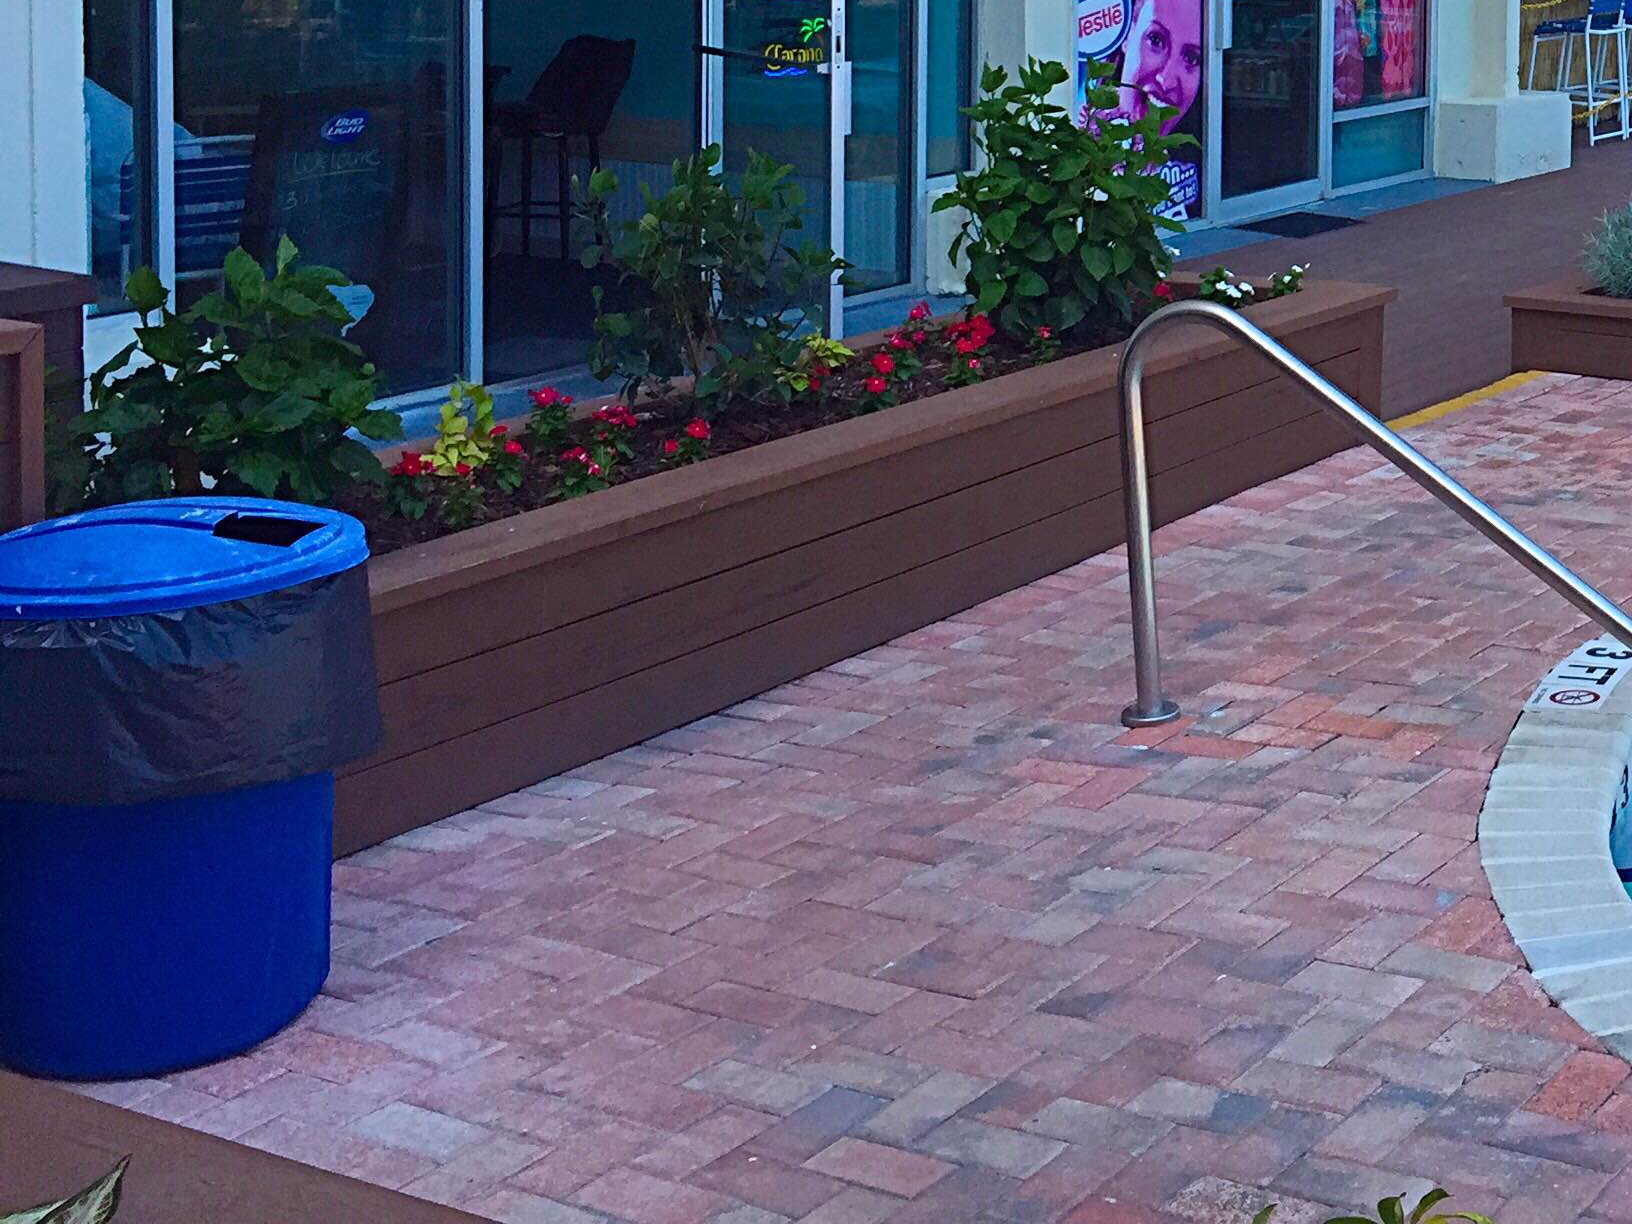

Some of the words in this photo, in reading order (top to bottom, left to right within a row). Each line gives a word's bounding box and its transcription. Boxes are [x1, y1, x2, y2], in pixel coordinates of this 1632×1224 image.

[335, 117, 365, 127] BUD
[327, 125, 366, 136] LIGHT
[1557, 664, 1618, 686] FT
